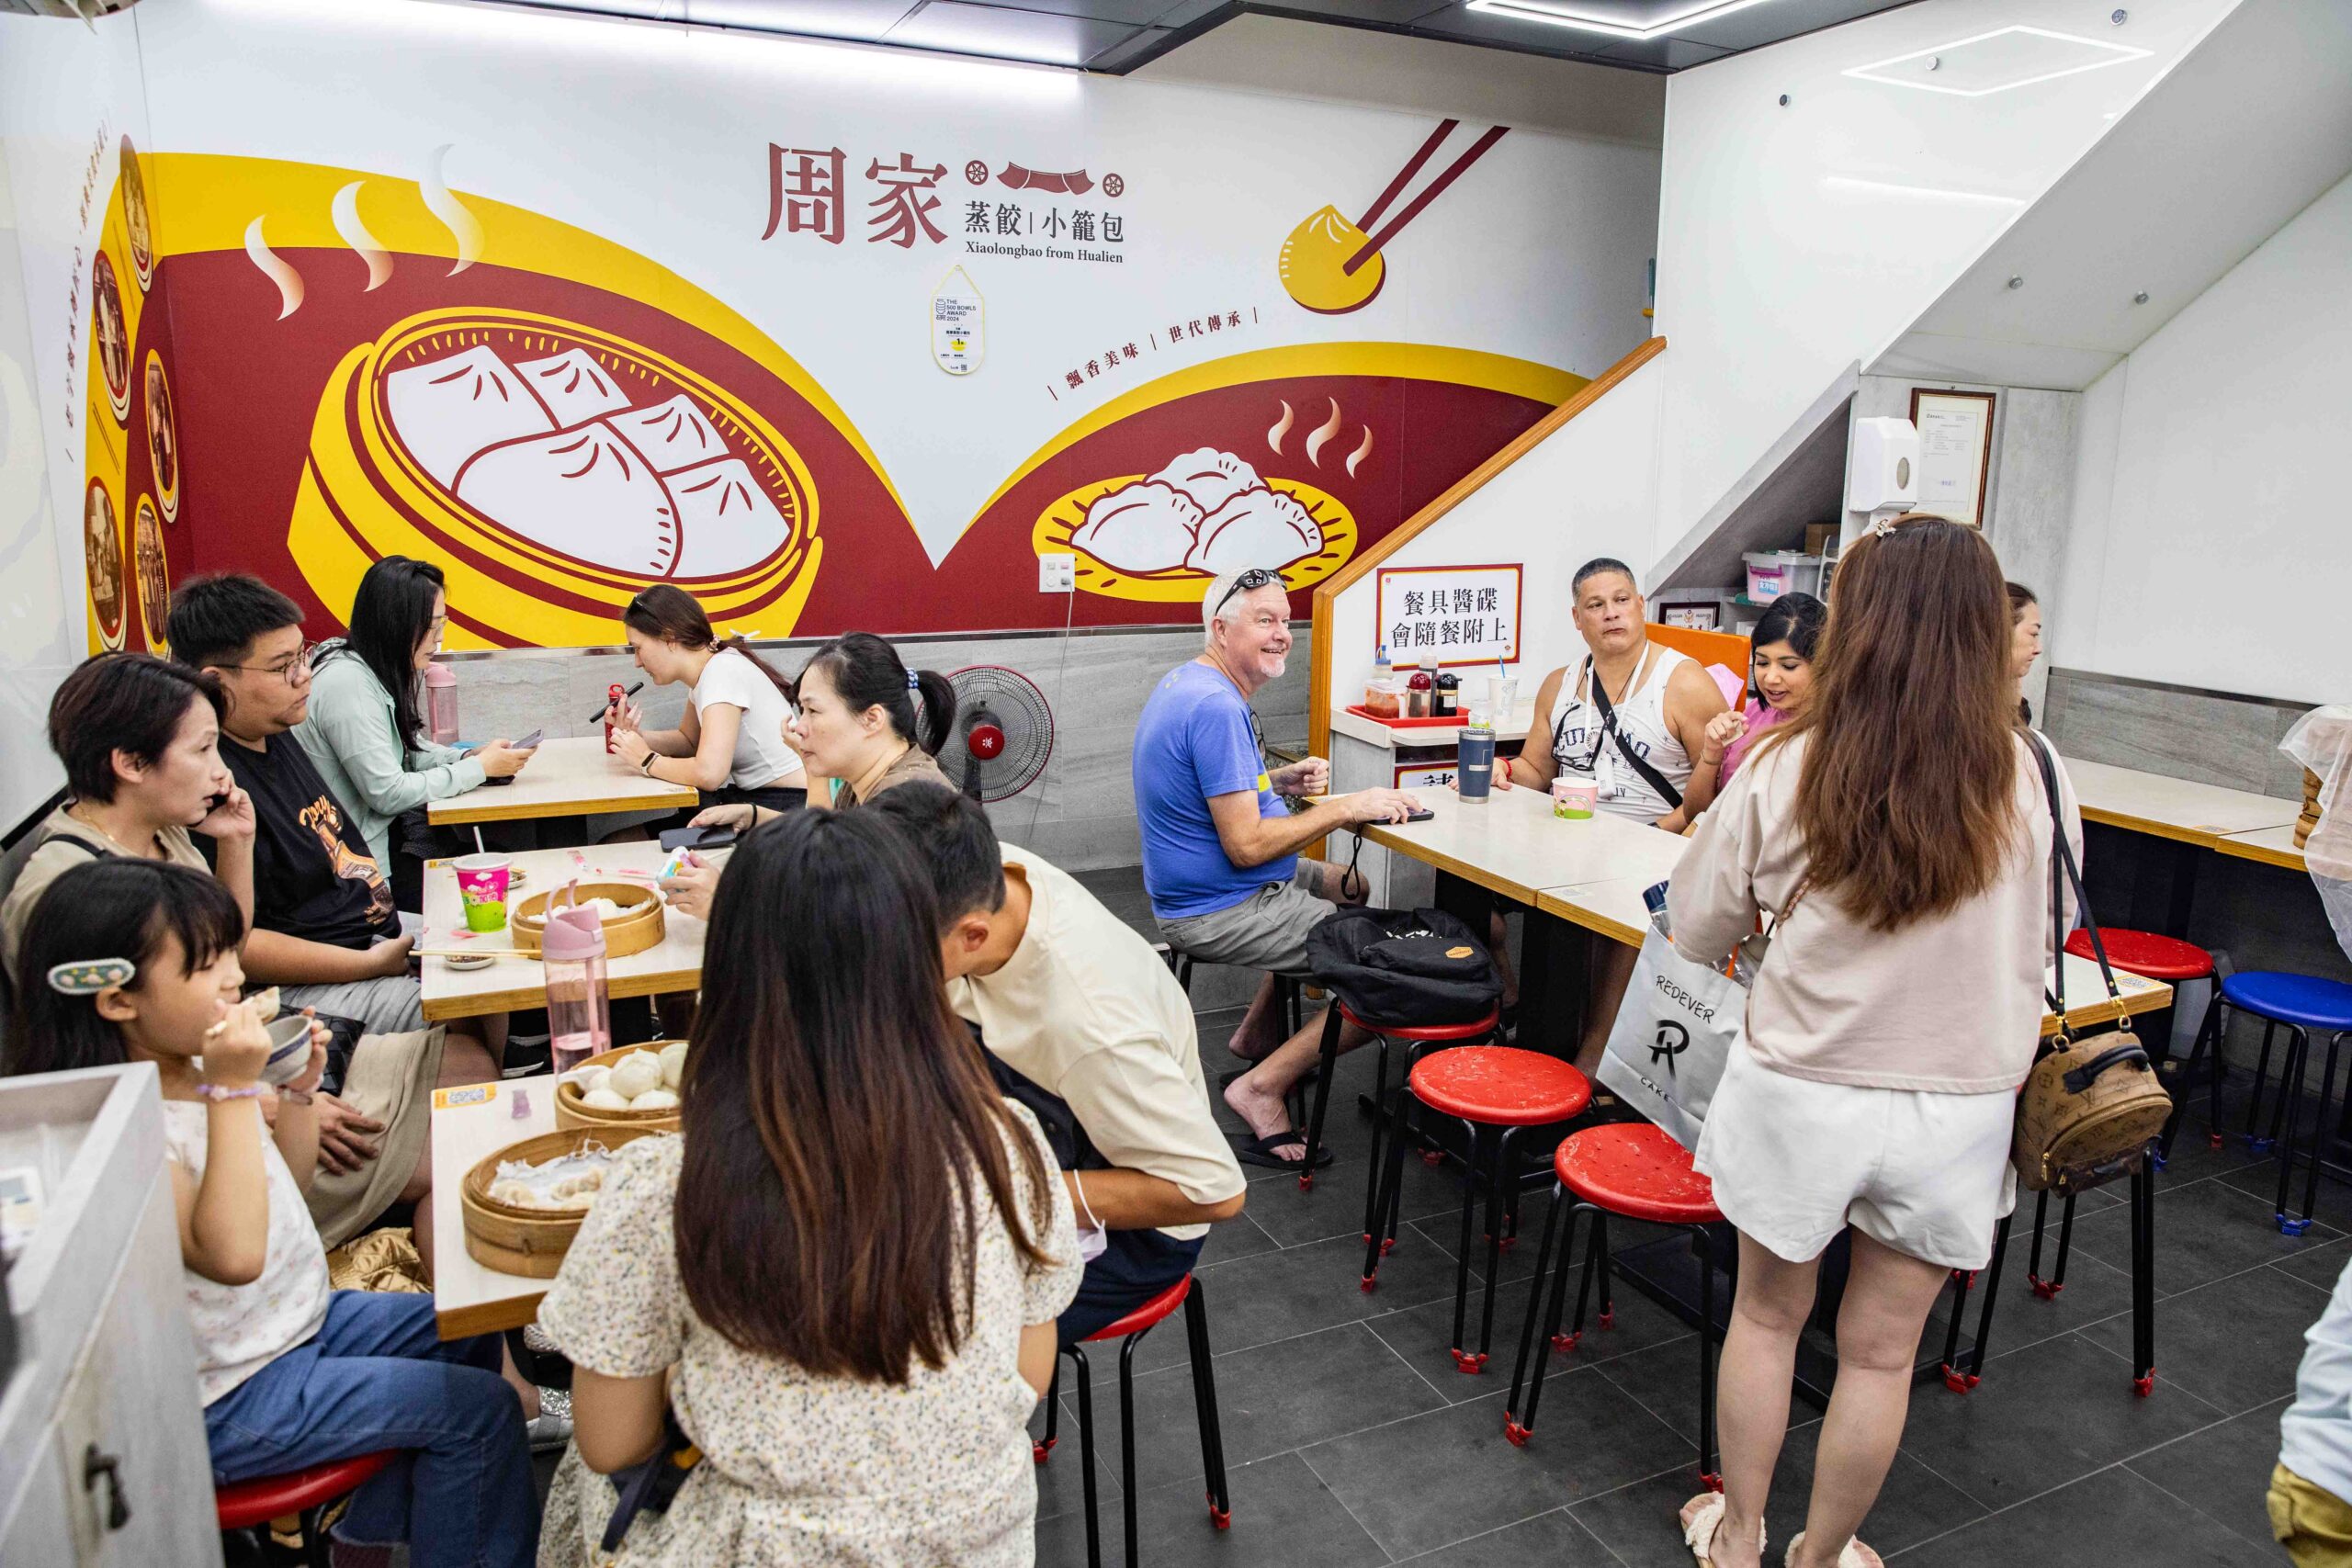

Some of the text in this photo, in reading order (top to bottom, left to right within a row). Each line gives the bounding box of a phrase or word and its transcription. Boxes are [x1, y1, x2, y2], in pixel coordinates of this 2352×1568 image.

[761, 142, 948, 249] 周家
[966, 241, 1124, 264] Xiaolongbao from Hualien
[1168, 310, 1241, 344] 世代傳承
[1404, 587, 1498, 616] 餐具醬碟
[1391, 617, 1508, 649] 會隨餐附上
[1656, 975, 1715, 1025] REDEVER
[1640, 1076, 1670, 1102] CAKE
